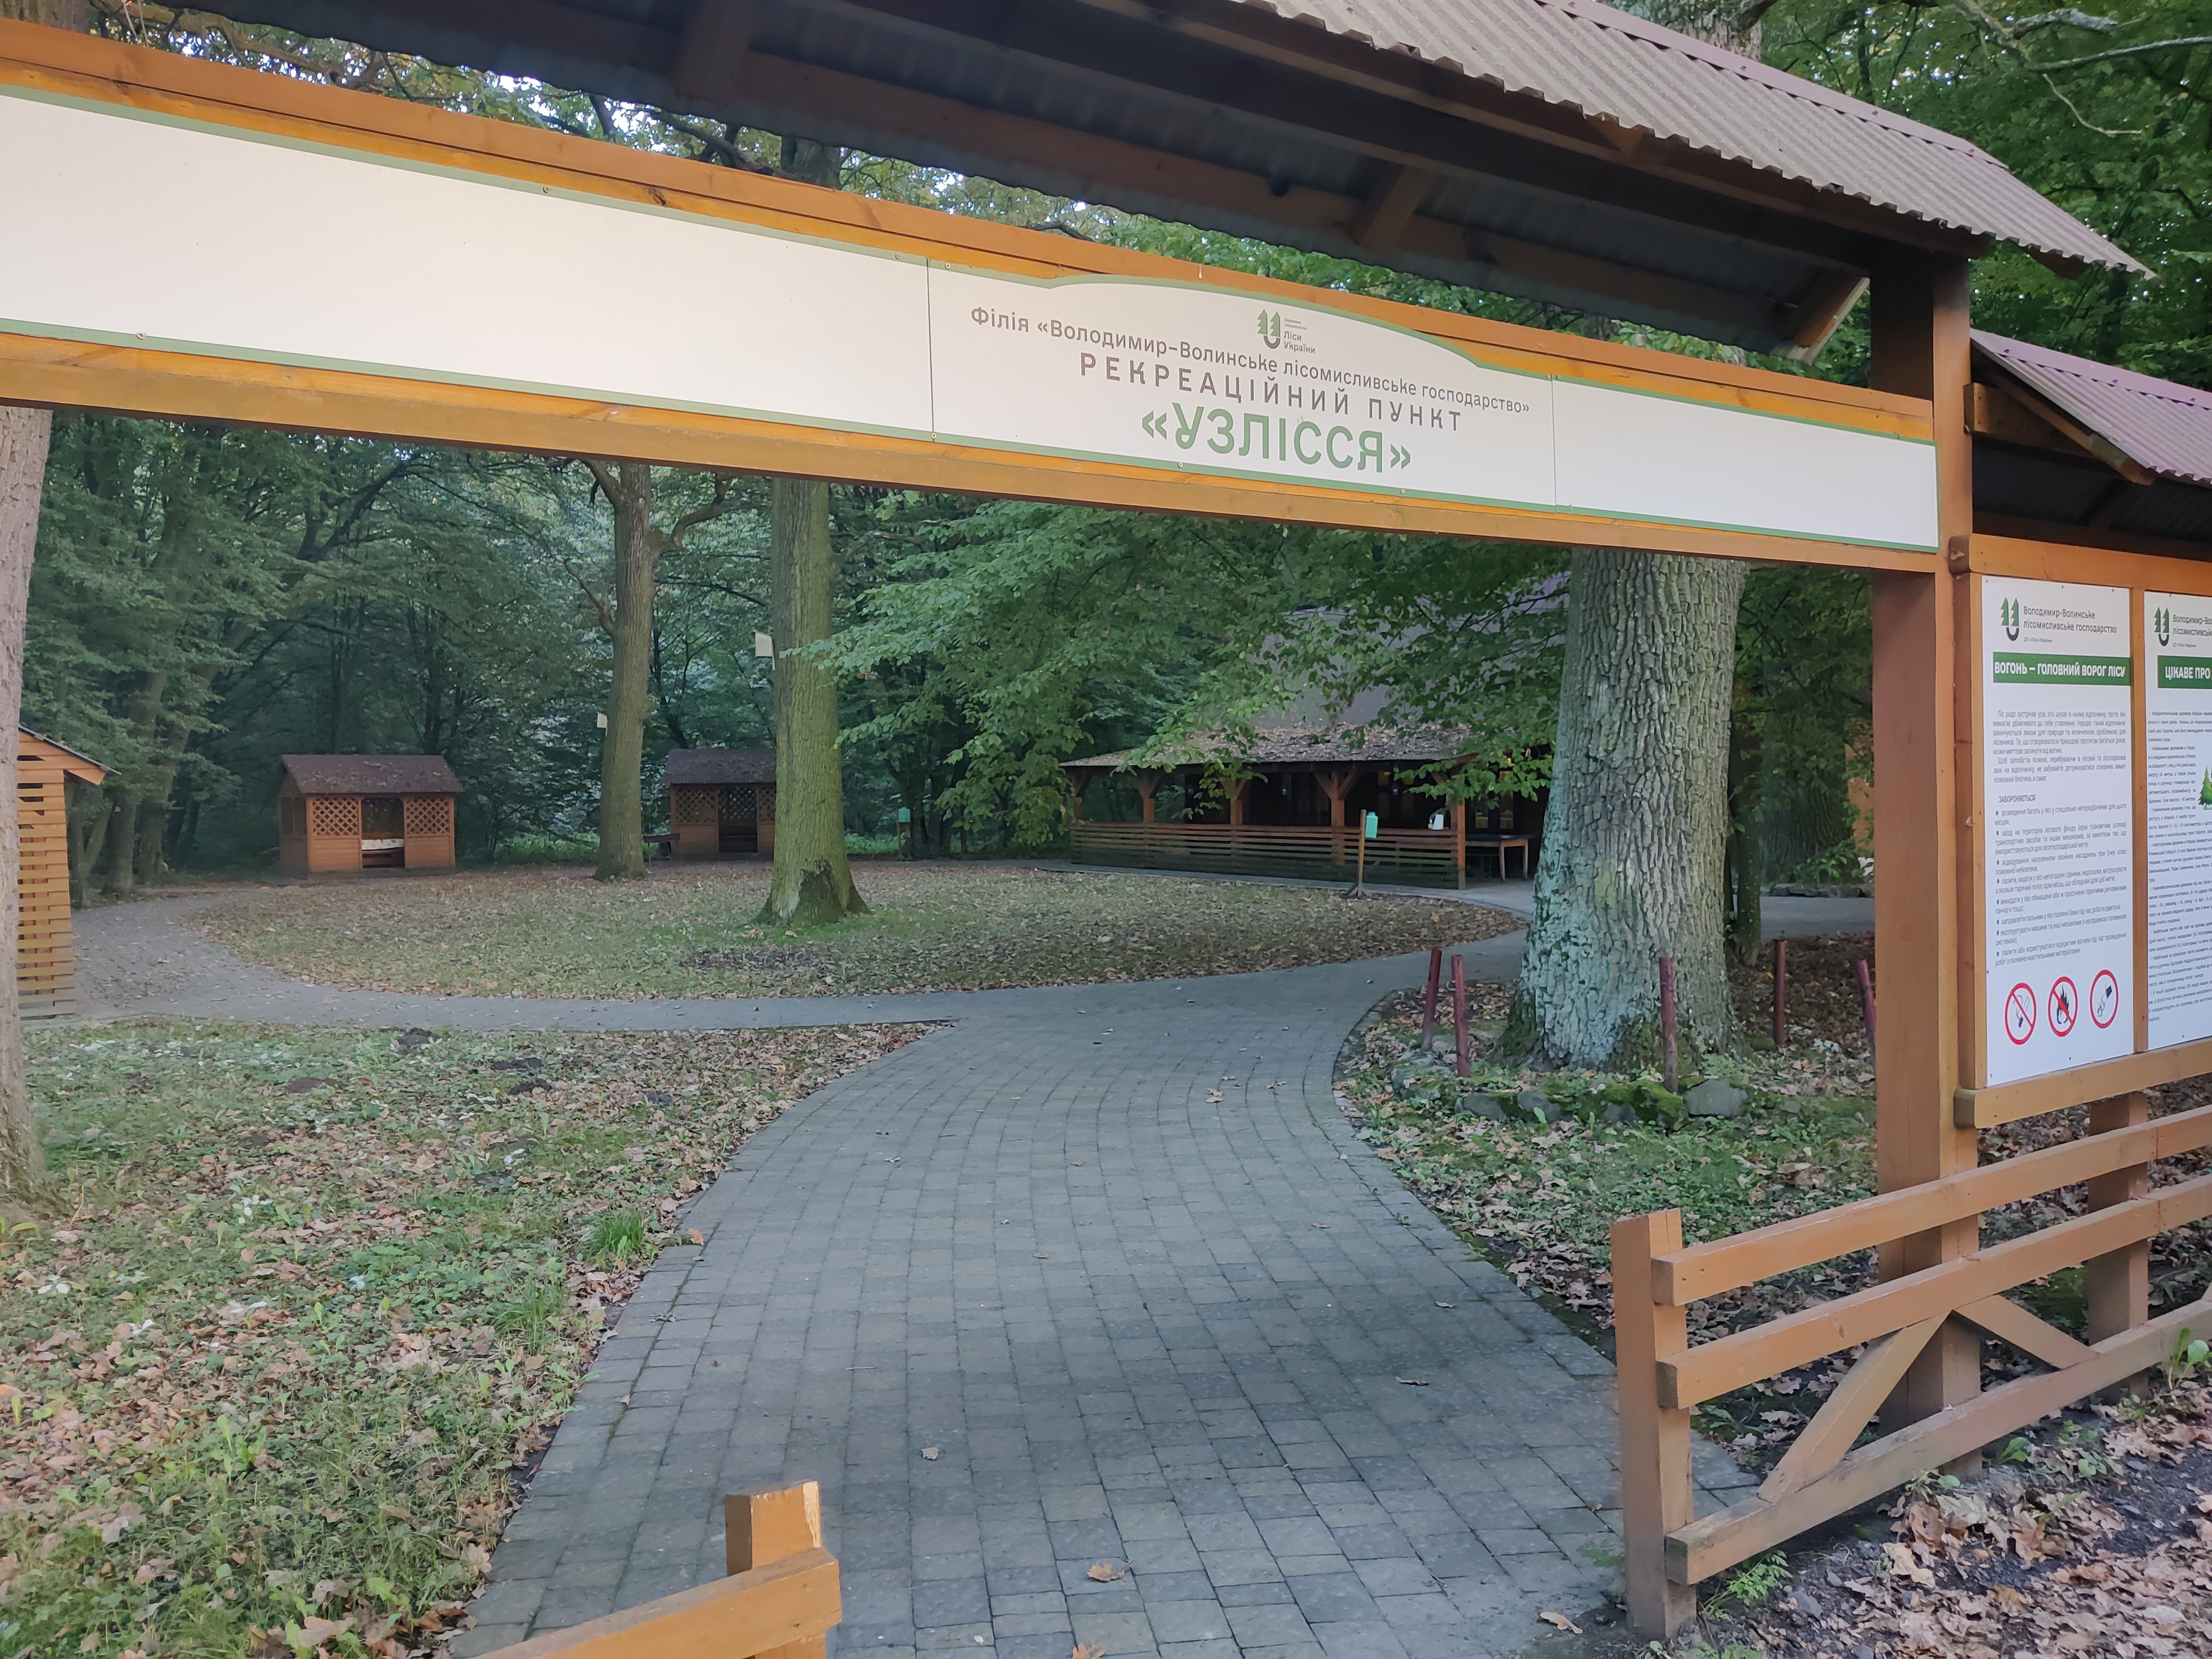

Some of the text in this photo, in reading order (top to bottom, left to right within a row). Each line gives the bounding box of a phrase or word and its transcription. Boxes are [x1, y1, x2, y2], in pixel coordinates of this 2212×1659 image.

[1284, 331, 1302, 341] Ліси
[1284, 341, 1316, 354] України
[971, 307, 1530, 413] Філія «Володимир-Волинське лісомисливське господарство»
[1080, 352, 1460, 431] РЕКРЕАЦІЙНИЙ ПУНКТ
[1141, 402, 1411, 473] «УЗЛІССЯ»
[2023, 606, 2095, 619] Володимир-Волинське
[2173, 614, 2212, 625] Володимир-Во
[2023, 619, 2117, 634] лісомисливське господарство
[1995, 661, 2027, 674] ВОГОНЬ
[2037, 662, 2080, 676] ГОЛОВНИЙ
[2081, 664, 2106, 676] ВОРОГ
[2107, 665, 2126, 677] ЛІСУ
[2165, 666, 2210, 680] ЦІКАВЕ ПРО
